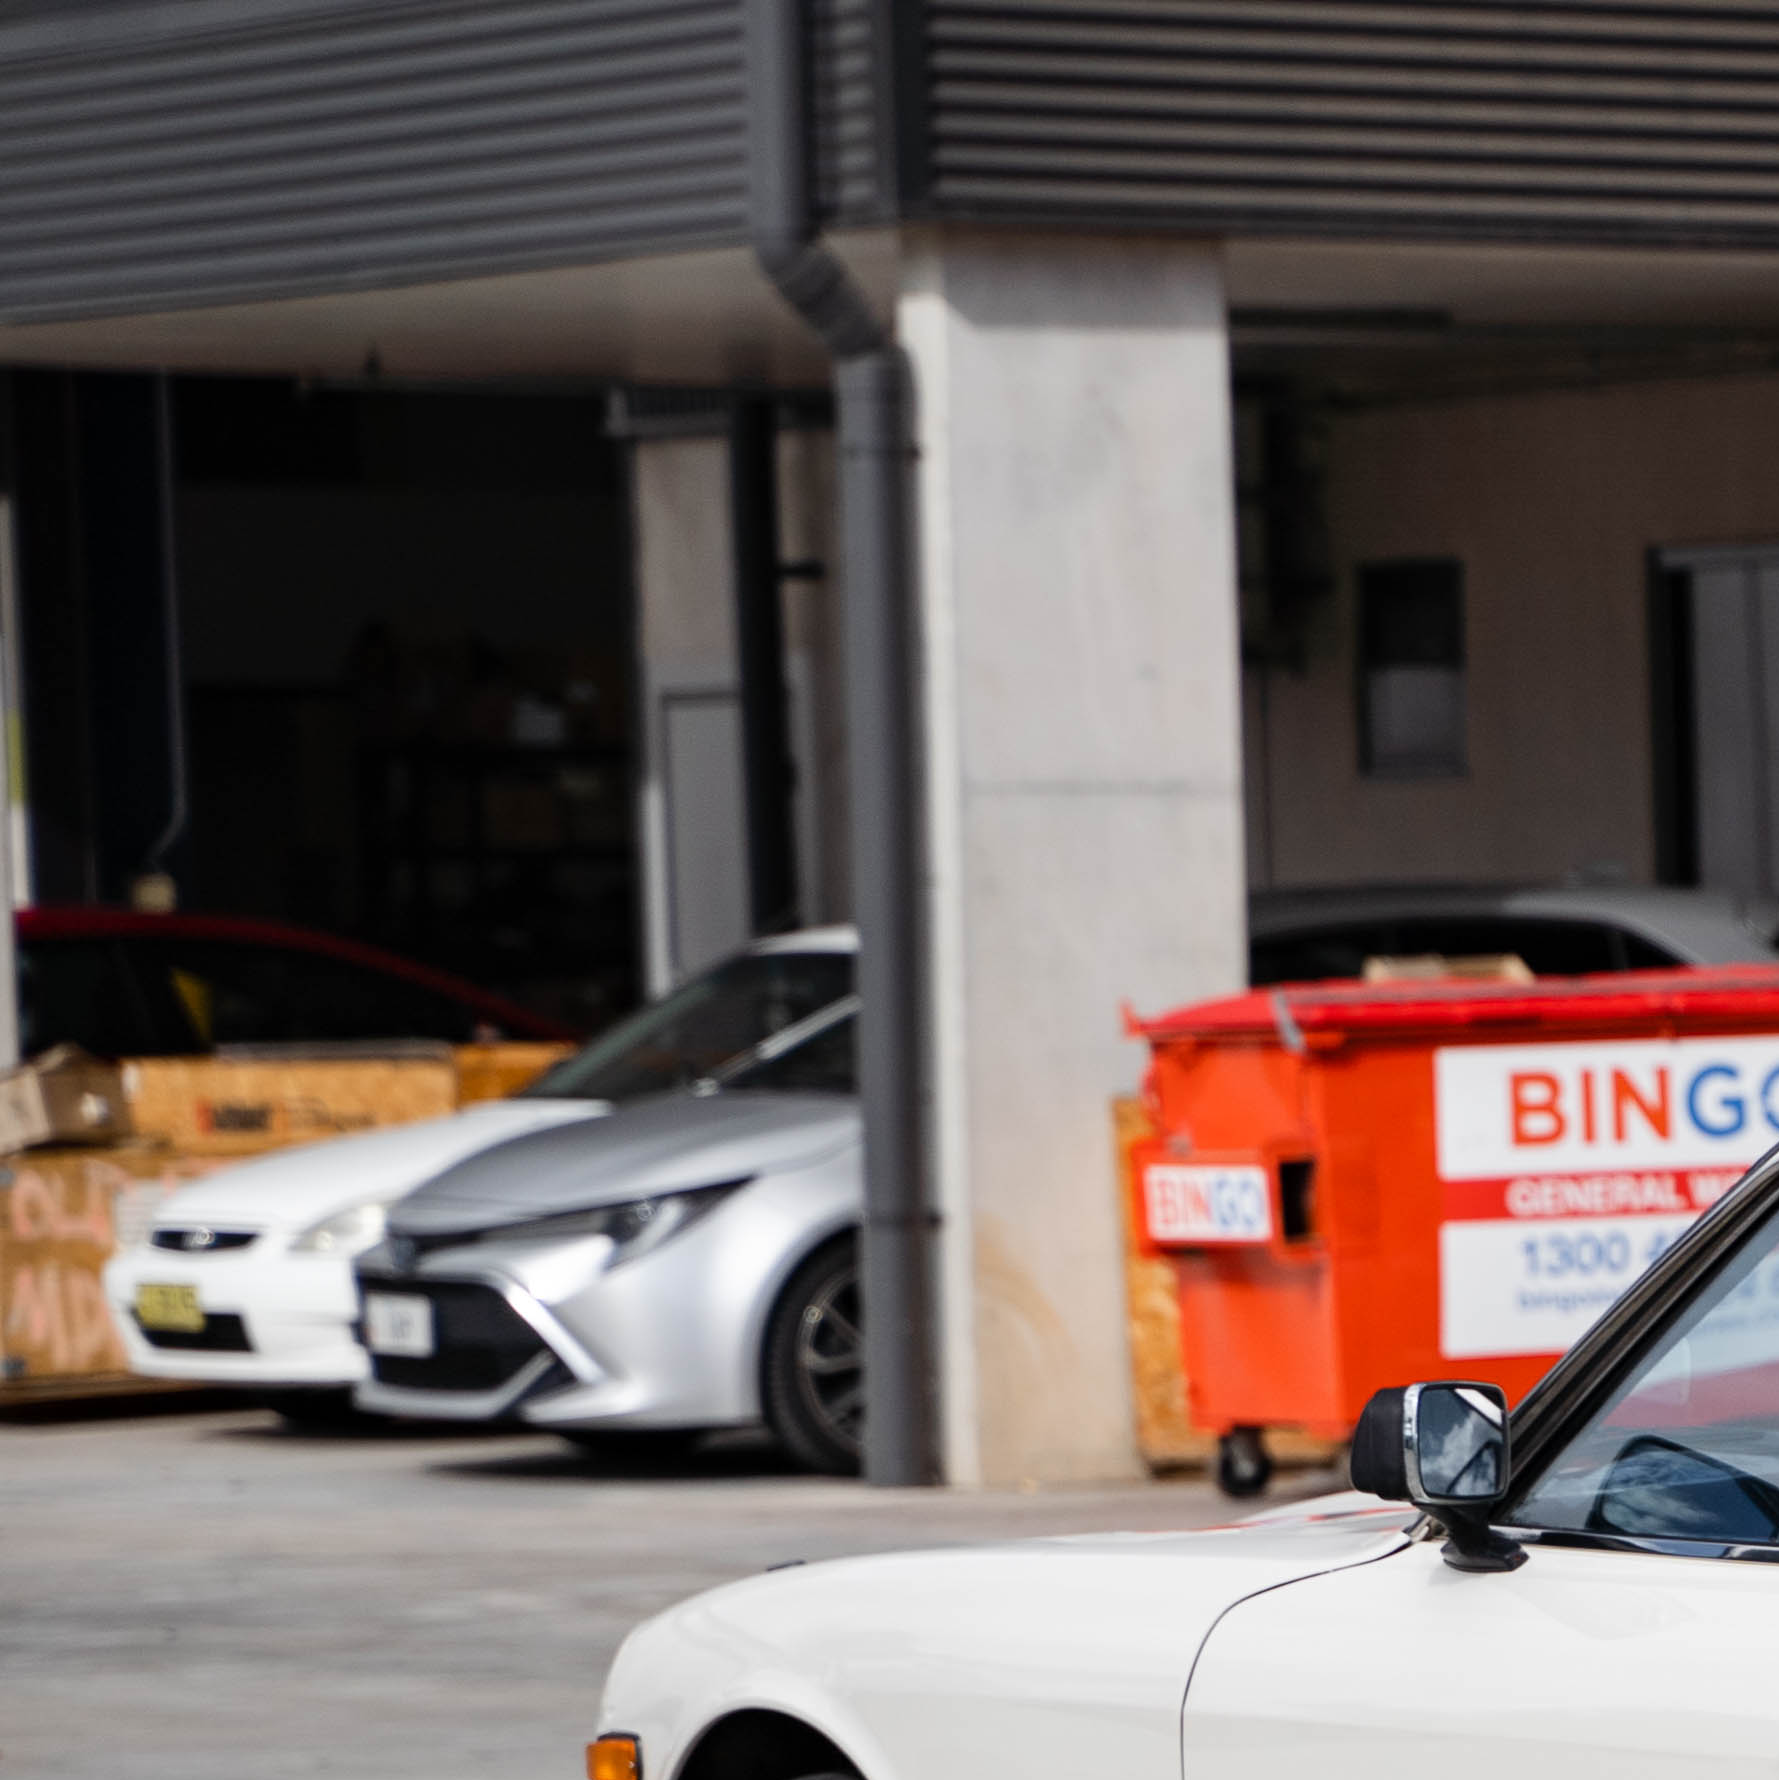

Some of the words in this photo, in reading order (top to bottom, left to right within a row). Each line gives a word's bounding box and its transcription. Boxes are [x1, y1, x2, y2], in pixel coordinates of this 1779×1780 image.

[1154, 1176, 1267, 1231] BINGO
[1504, 1172, 1687, 1217] GENERAL
[1522, 1230, 1630, 1277] 1300
